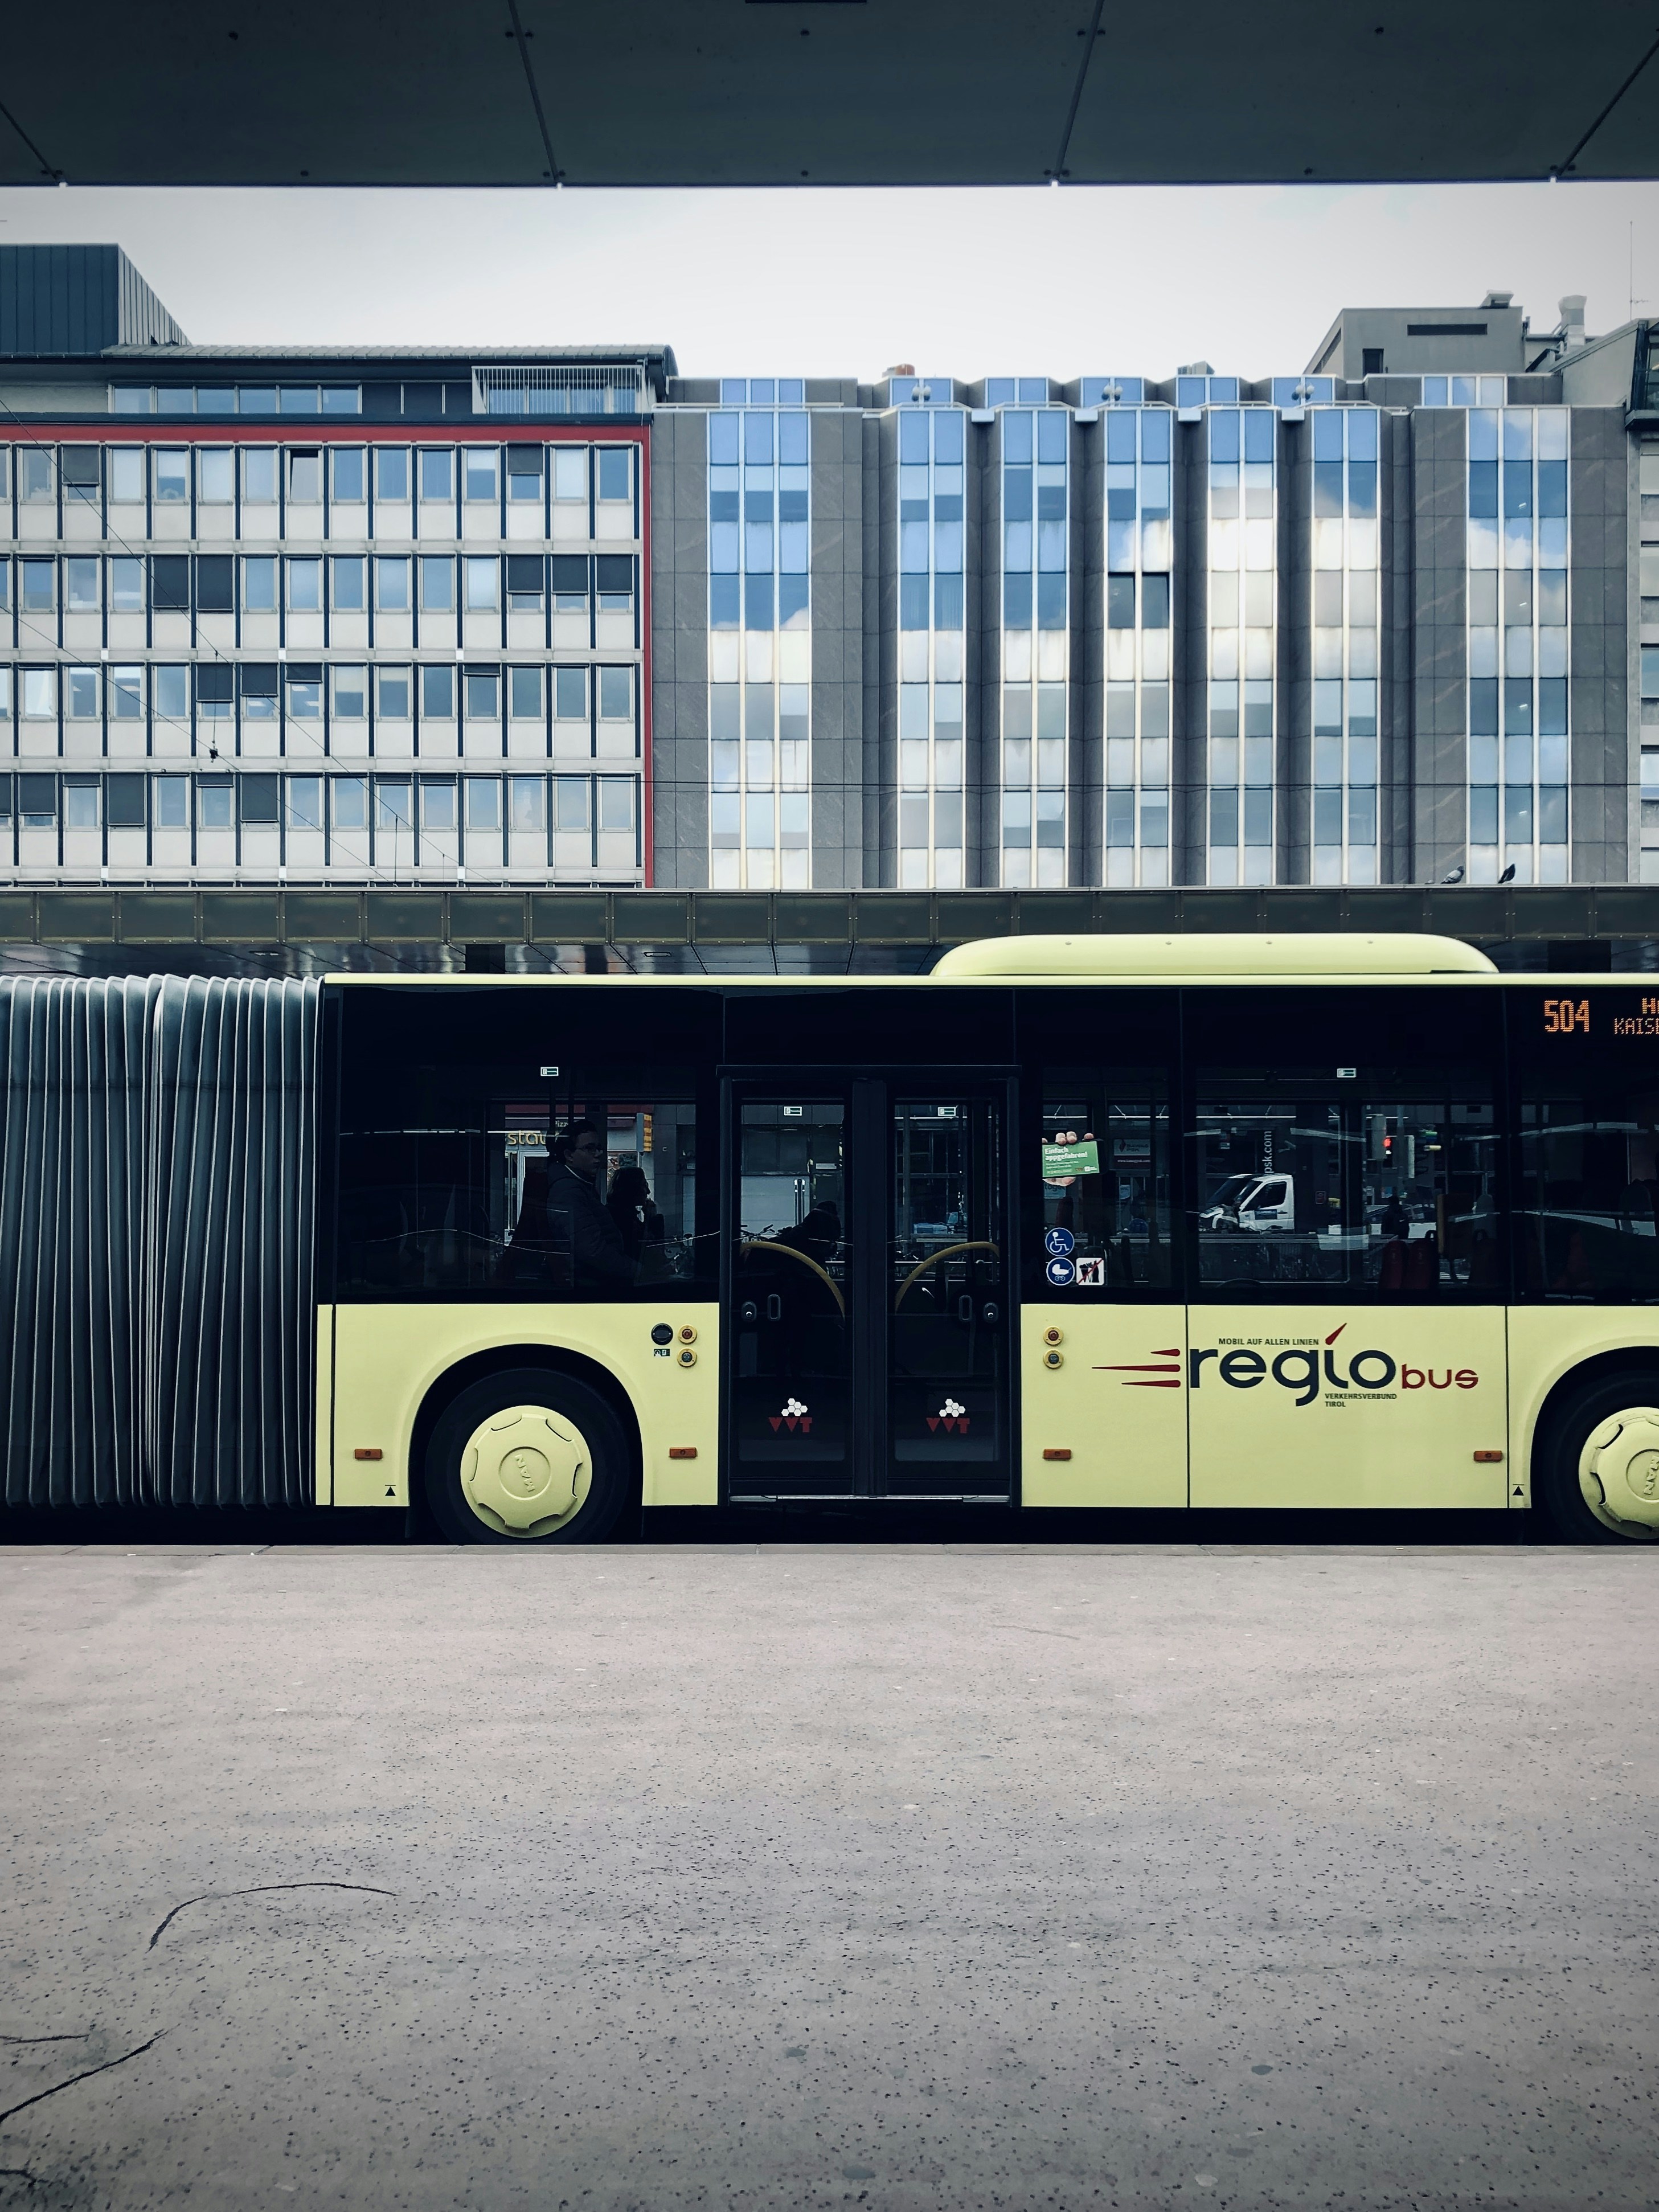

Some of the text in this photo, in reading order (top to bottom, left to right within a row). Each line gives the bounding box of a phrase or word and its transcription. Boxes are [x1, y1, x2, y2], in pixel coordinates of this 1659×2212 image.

[1544, 1000, 1590, 1033] 504
[1641, 997, 1659, 1014] H
[1045, 1151, 1088, 1161] appgefahren!
[1261, 1131, 1275, 1175] psk.com
[1190, 1322, 1479, 1407] regio bus
[769, 1416, 813, 1433] VVT
[926, 1417, 970, 1434] VVT
[514, 1454, 536, 1493] MAN
